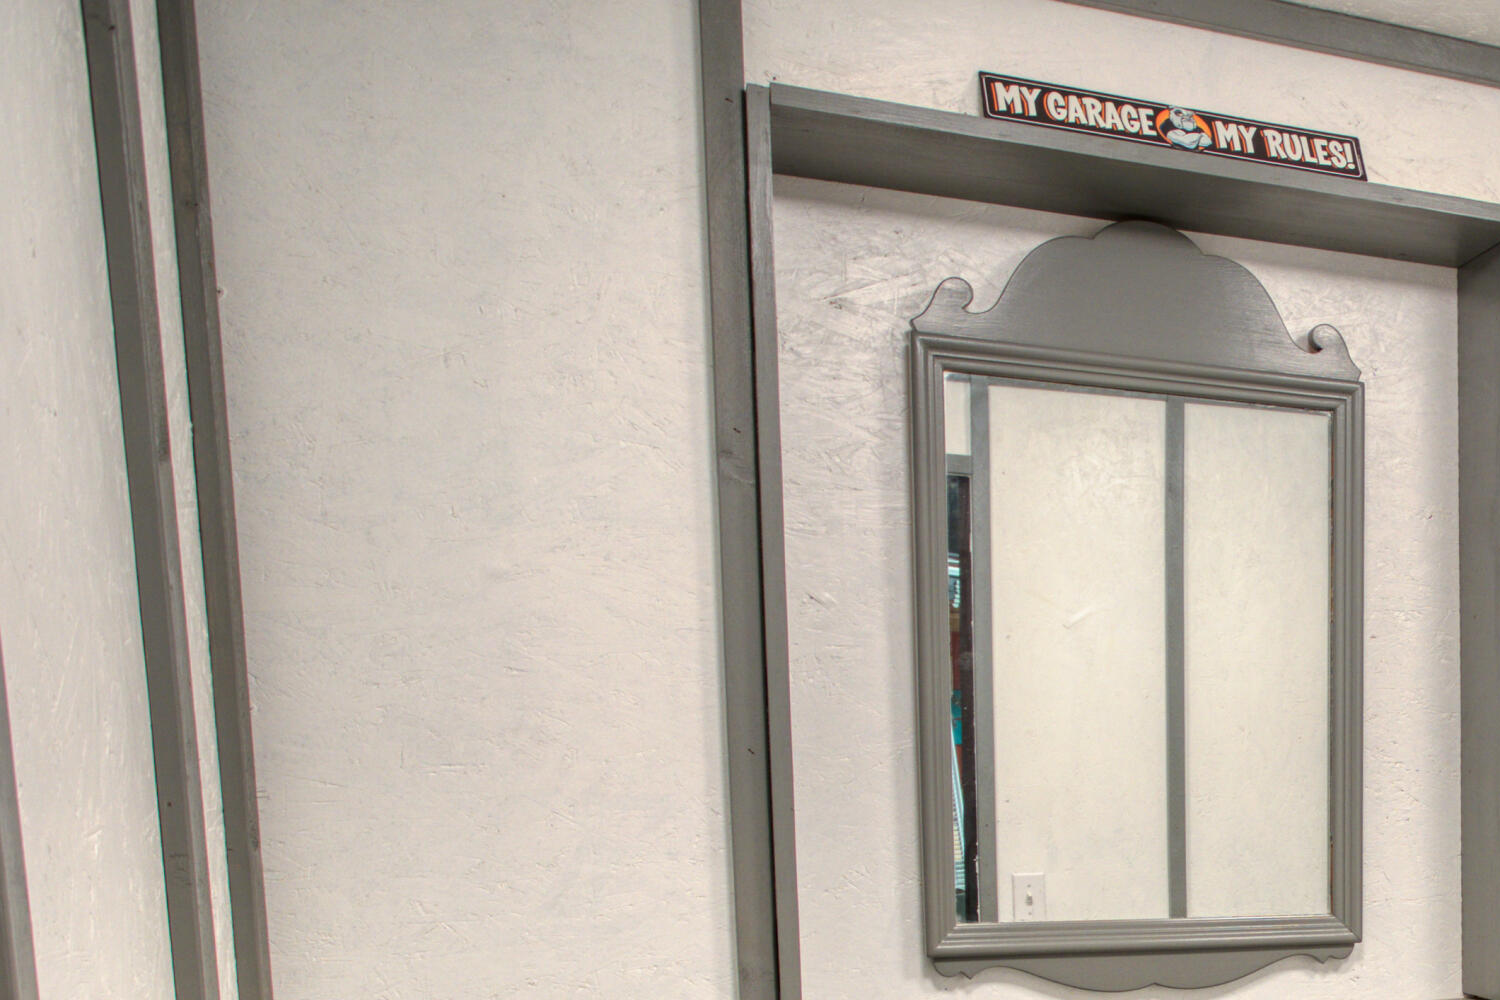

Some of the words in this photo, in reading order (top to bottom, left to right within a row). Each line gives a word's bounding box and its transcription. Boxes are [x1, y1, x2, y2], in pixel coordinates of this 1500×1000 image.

[991, 82, 1041, 117] MY
[1043, 91, 1158, 137] GARAGE
[1212, 120, 1257, 154] MY
[1261, 128, 1356, 170] RULES!
